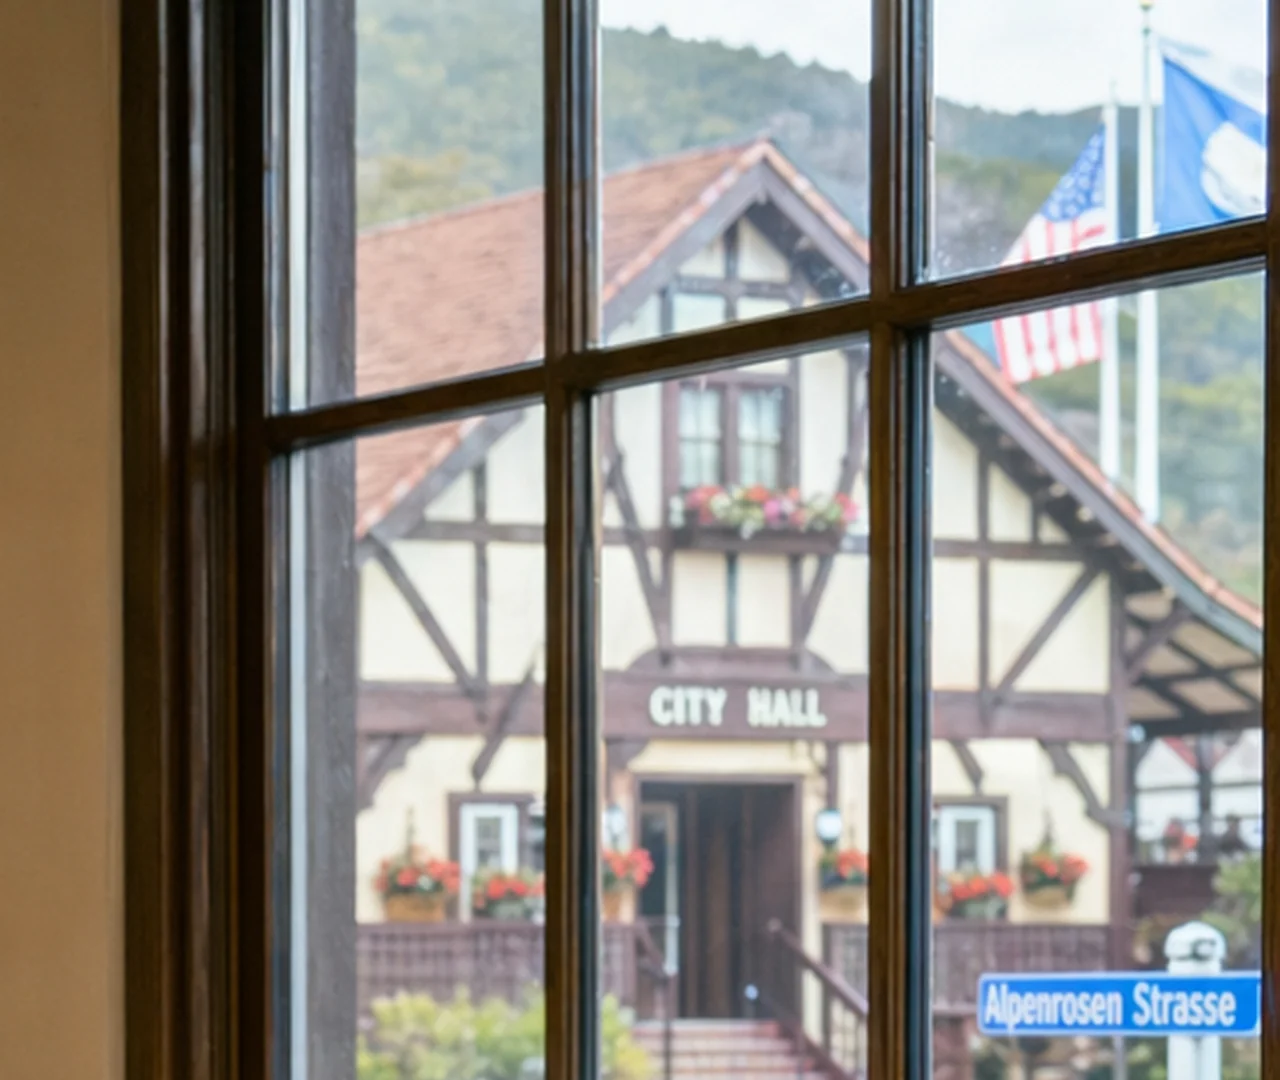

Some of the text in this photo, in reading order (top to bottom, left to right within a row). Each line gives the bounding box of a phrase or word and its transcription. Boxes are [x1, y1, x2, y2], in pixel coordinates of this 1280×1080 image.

[648, 685, 829, 728] CITY HALL
[984, 982, 1237, 1031] Alpenrosen Strasse
